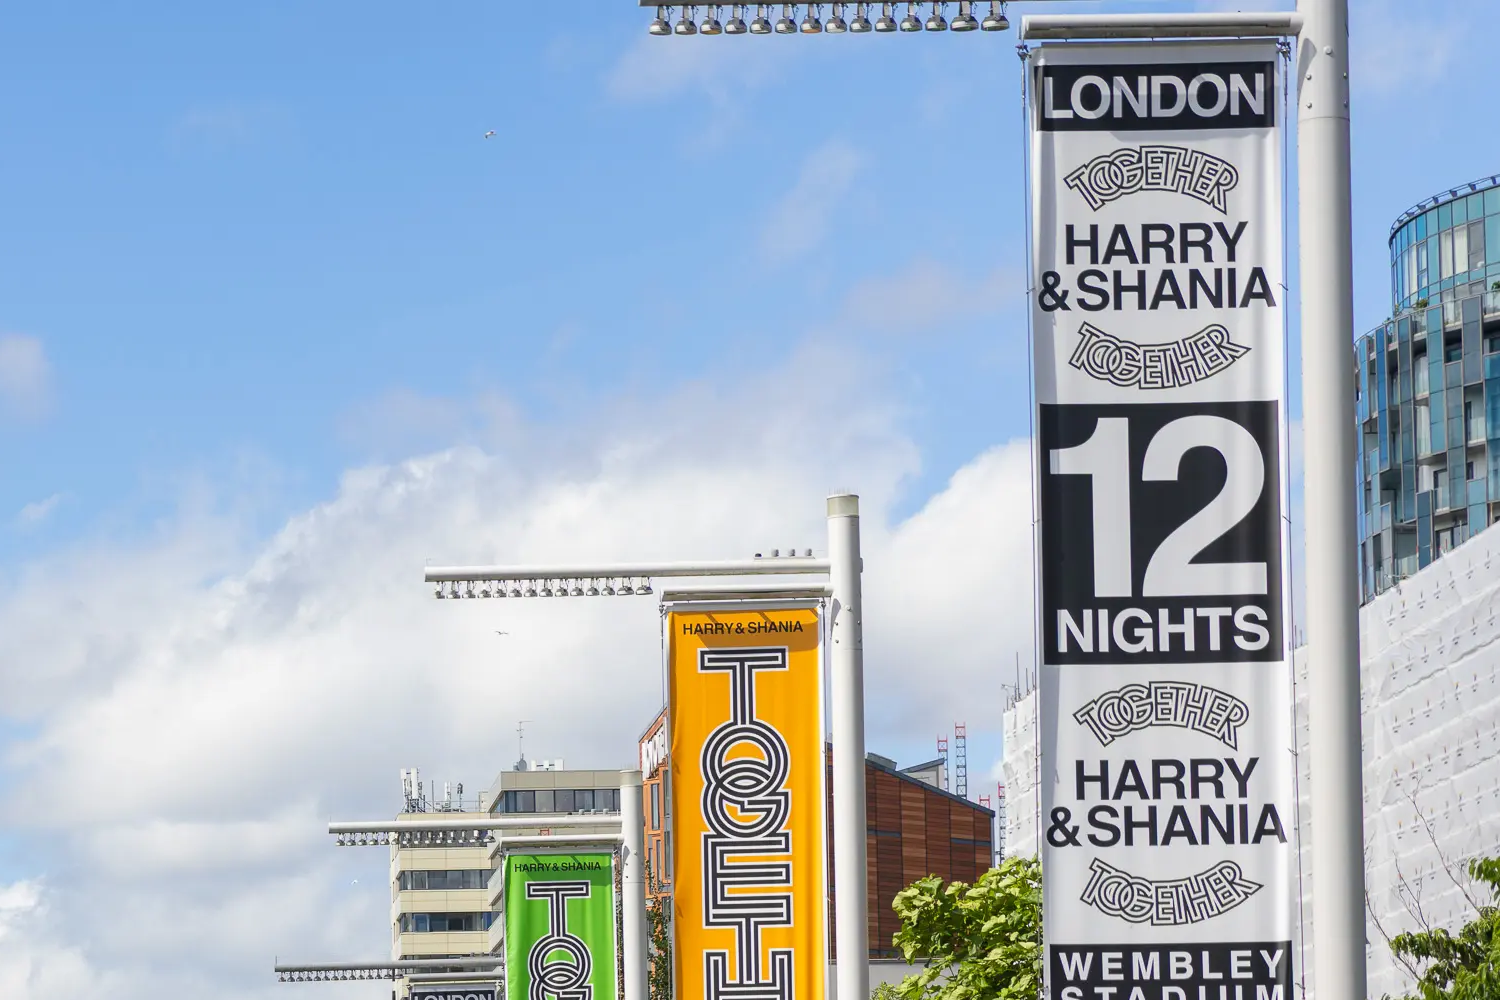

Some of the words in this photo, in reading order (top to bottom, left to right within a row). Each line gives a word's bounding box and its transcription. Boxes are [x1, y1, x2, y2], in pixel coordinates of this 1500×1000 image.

[1044, 73, 1265, 120] LONDON
[1063, 145, 1239, 215] TOGETHER
[1065, 221, 1248, 266] HARRY
[1069, 320, 1252, 390] TOGETHER
[1049, 414, 1268, 598] 12
[683, 622, 734, 635] HARRY
[747, 621, 803, 634] SHANIA
[1057, 606, 1270, 654] NIGHTS
[1072, 680, 1249, 752] TOGETHER
[1075, 757, 1259, 801] HARRY
[515, 863, 552, 872] HARRY
[561, 862, 601, 872] SHANIA
[1080, 857, 1264, 926] TOGETHER
[1059, 949, 1284, 982] WEMBLEY
